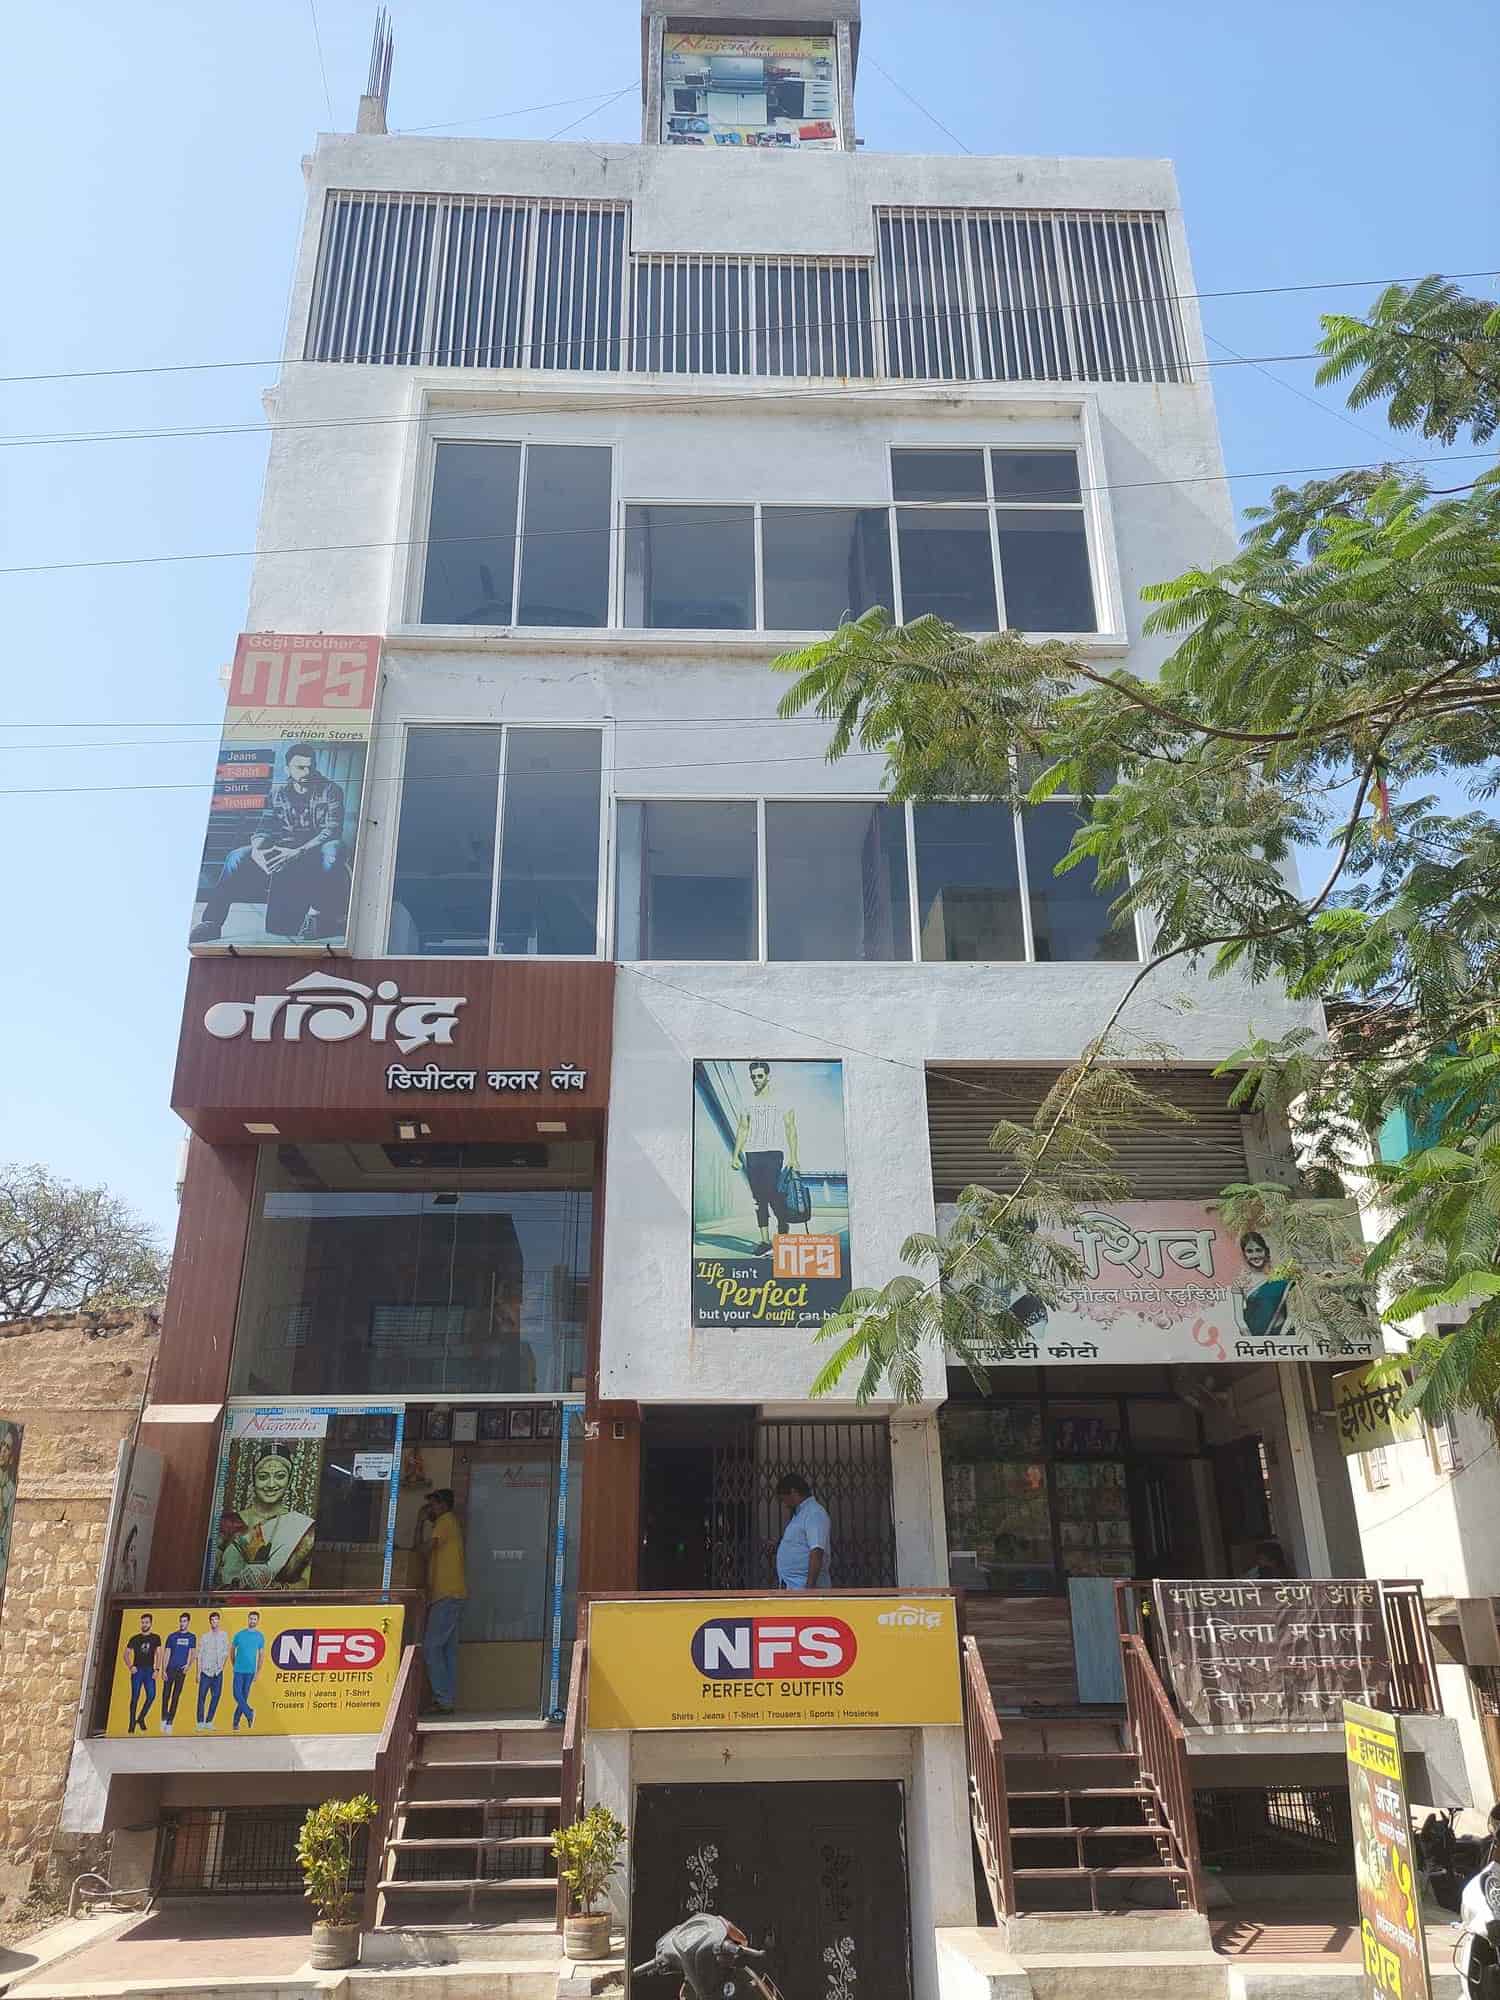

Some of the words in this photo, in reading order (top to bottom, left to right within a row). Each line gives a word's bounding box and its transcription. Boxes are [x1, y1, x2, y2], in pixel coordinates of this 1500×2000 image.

[248, 636, 288, 649] Gogi
[280, 729, 325, 739] Fashion
[327, 730, 364, 739] Stores
[227, 752, 257, 761] Jeans
[386, 1065, 477, 1091] डिजीटल
[487, 1068, 541, 1091] कलर
[550, 1064, 587, 1090] लॅब
[696, 1262, 725, 1285] Life
[732, 1268, 758, 1279] isn't
[716, 1278, 809, 1319] Perfect
[699, 1308, 720, 1320] but
[723, 1310, 751, 1322] your
[765, 1308, 796, 1327] outfit
[799, 1311, 820, 1321] can
[1048, 1341, 1100, 1359] फोटो
[1235, 1340, 1309, 1357] मिनीटात
[279, 1634, 376, 1665] NFS
[704, 1626, 843, 1670] NFS
[275, 1672, 325, 1683] PERFECT
[329, 1671, 374, 1682] OUTFITS
[284, 1689, 306, 1697] Shirts
[314, 1689, 337, 1697] Jeans
[345, 1689, 370, 1697] T-Shirt
[702, 1682, 774, 1698] PERFECT
[780, 1681, 844, 1697] OUTFITS
[271, 1701, 304, 1709] Trousers
[312, 1701, 337, 1710] Sports
[671, 1712, 694, 1720] Shirts
[702, 1711, 725, 1720] Jeans
[734, 1710, 760, 1719] T-Shirt
[767, 1710, 801, 1719] Trousers
[809, 1709, 834, 1719] Sports
